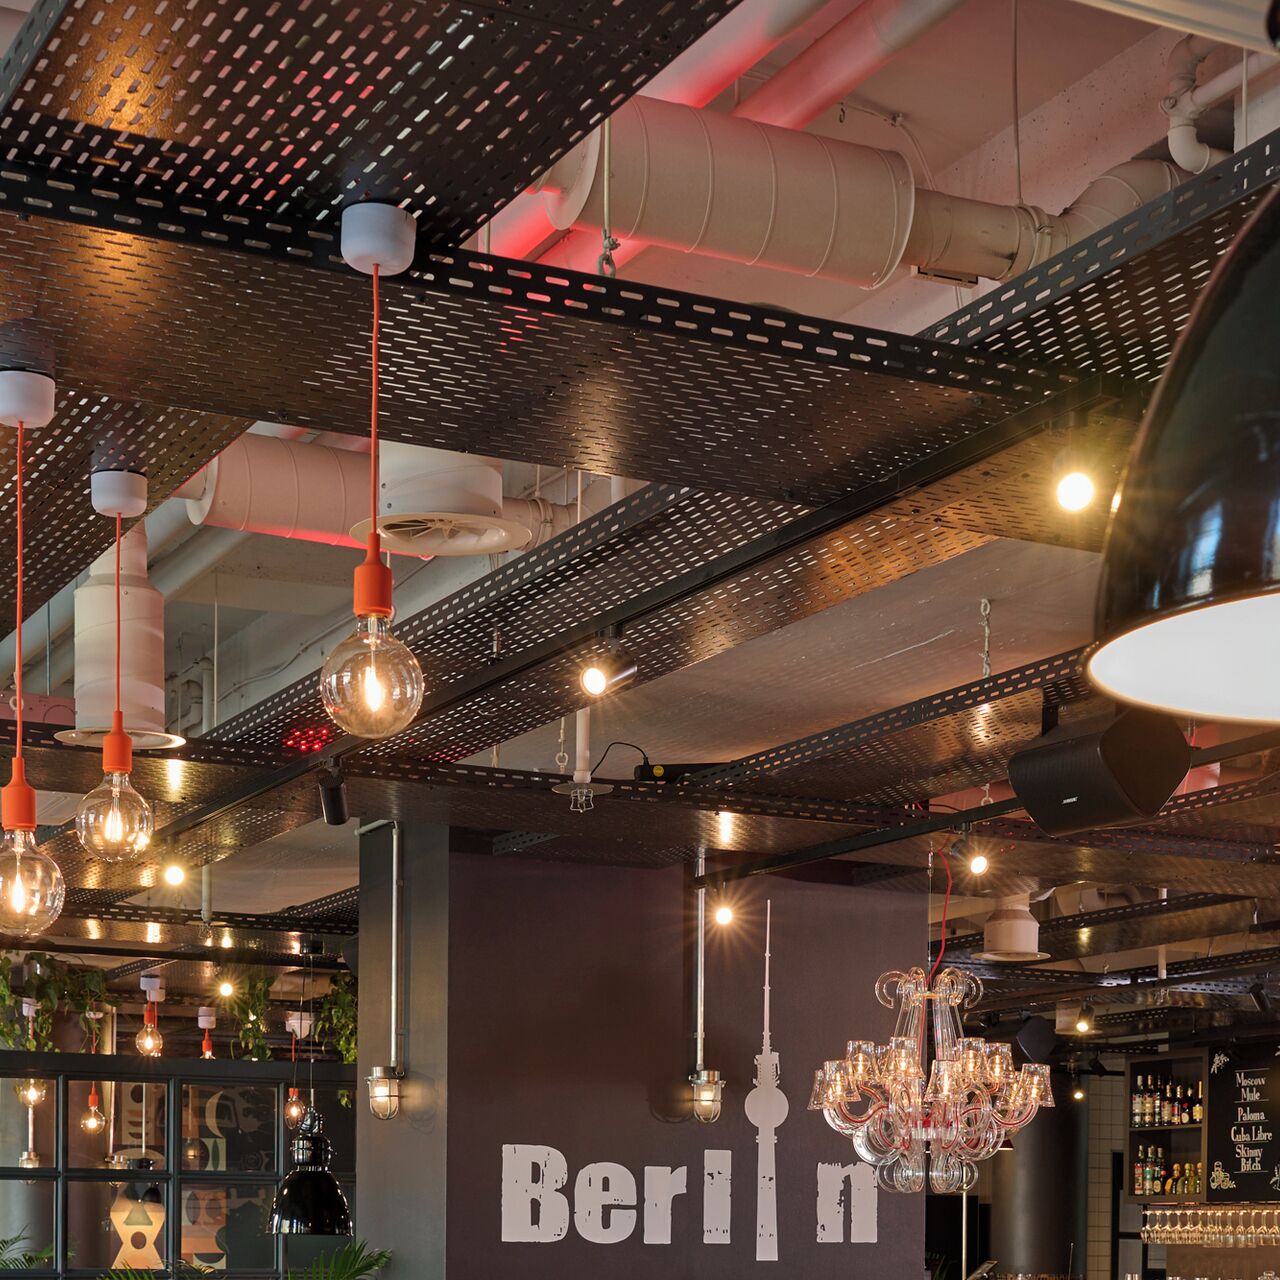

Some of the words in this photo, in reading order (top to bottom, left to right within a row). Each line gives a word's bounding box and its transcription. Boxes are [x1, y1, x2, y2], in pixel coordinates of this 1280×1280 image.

[1235, 1072, 1266, 1087] Moscow
[1241, 1087, 1261, 1101] Mule
[1237, 1107, 1266, 1121] Paloma
[1231, 1126, 1251, 1142] Cuba
[1252, 1126, 1273, 1141] Libre
[1235, 1144, 1263, 1159] Skinny
[1241, 1158, 1261, 1172] Bitch
[501, 1142, 878, 1261] Berlin
